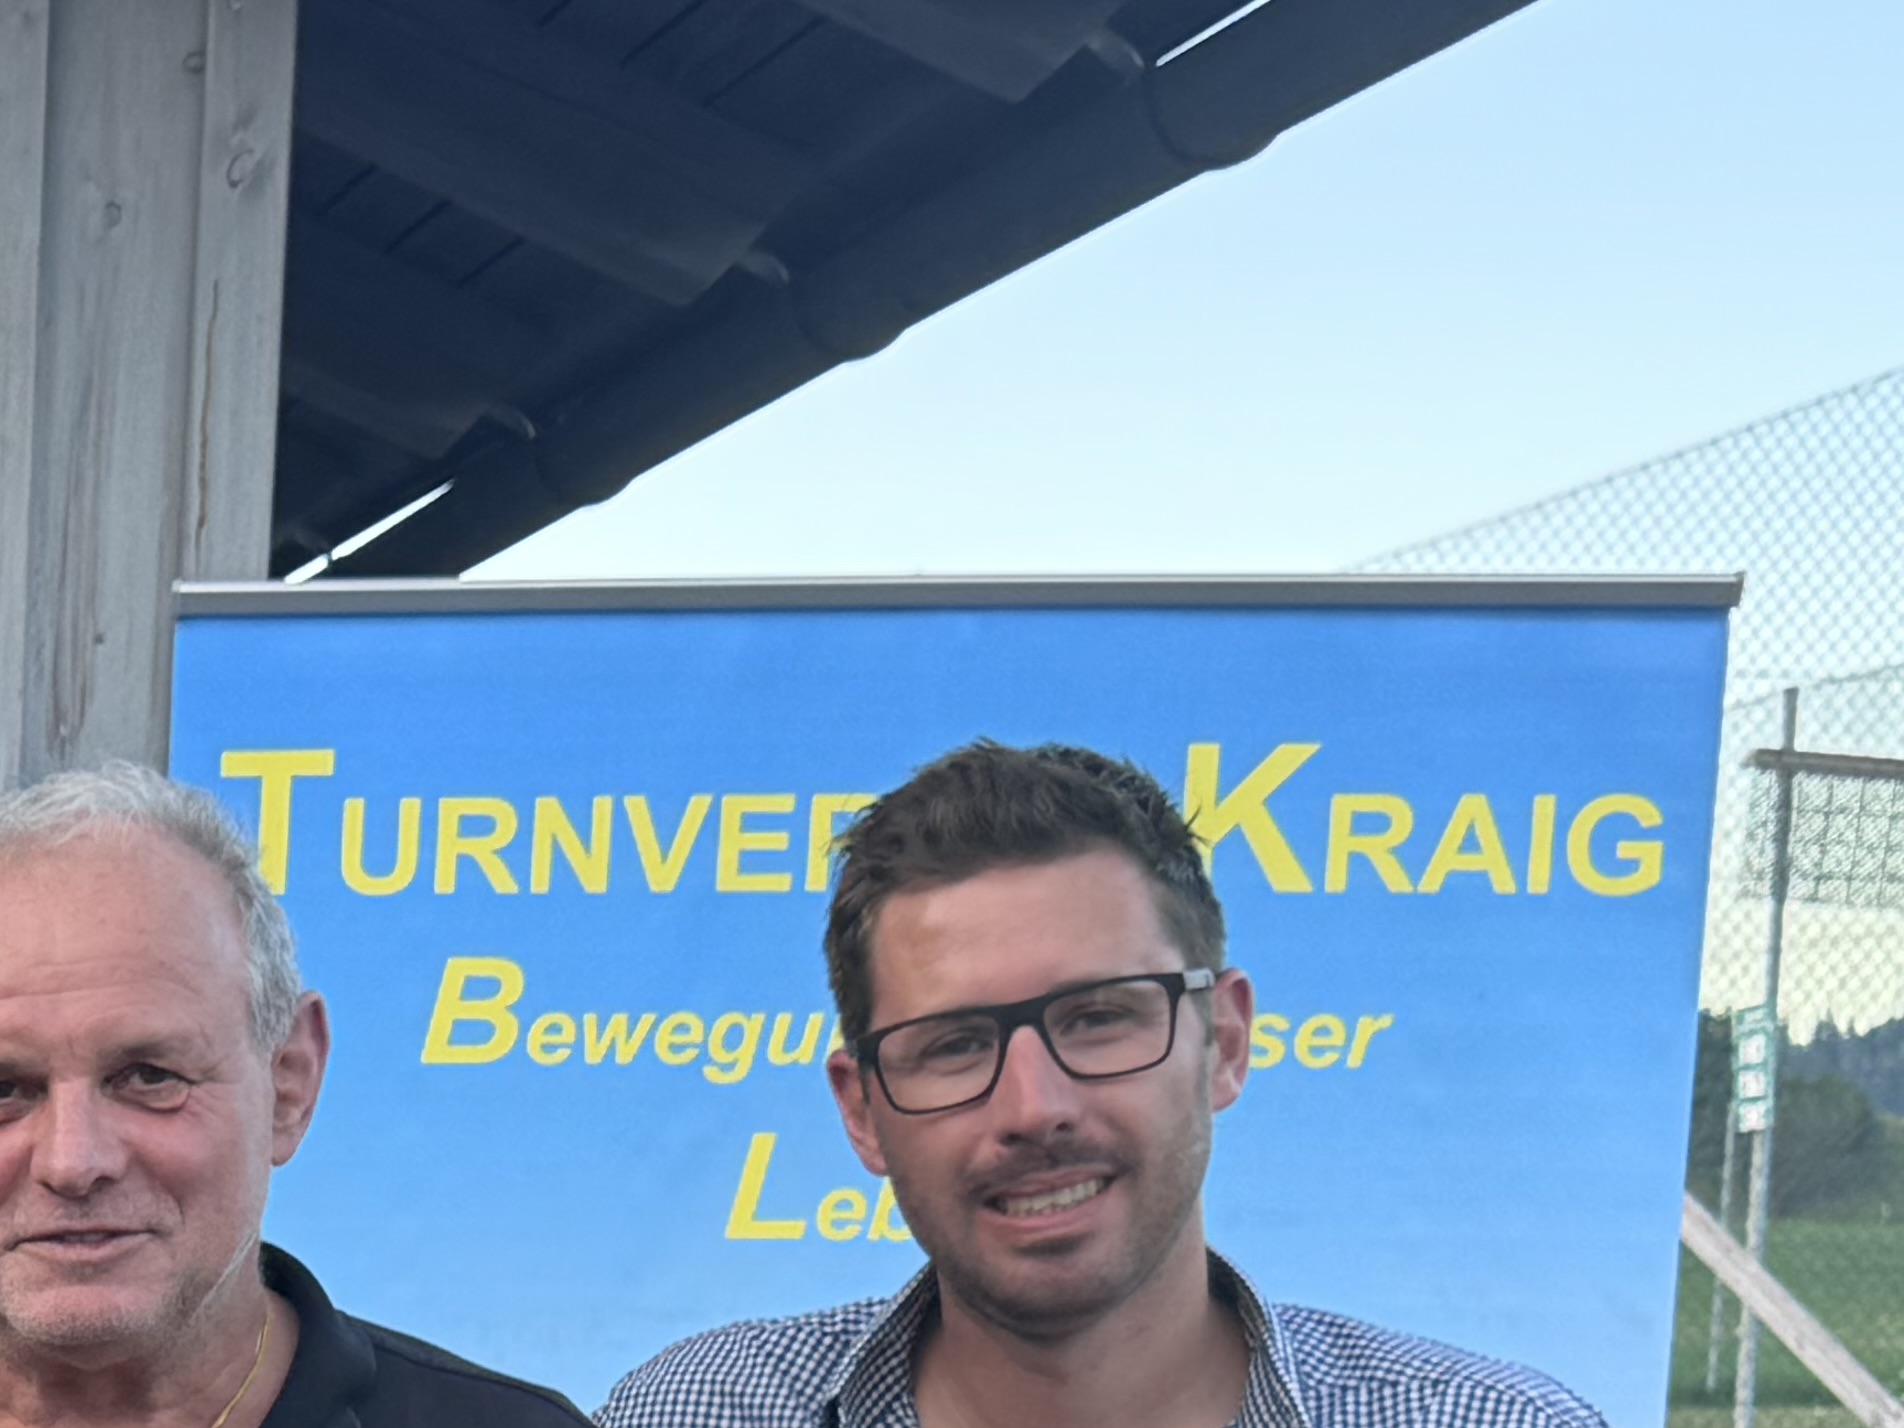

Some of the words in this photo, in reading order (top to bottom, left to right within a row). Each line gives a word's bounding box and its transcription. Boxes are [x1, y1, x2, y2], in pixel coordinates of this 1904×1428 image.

[220, 748, 882, 897] TURNVER
[1182, 741, 1665, 897] KRAIG
[420, 956, 844, 1085] Bewegu
[1248, 1012, 1396, 1071] ser
[724, 1130, 914, 1242] Leb
